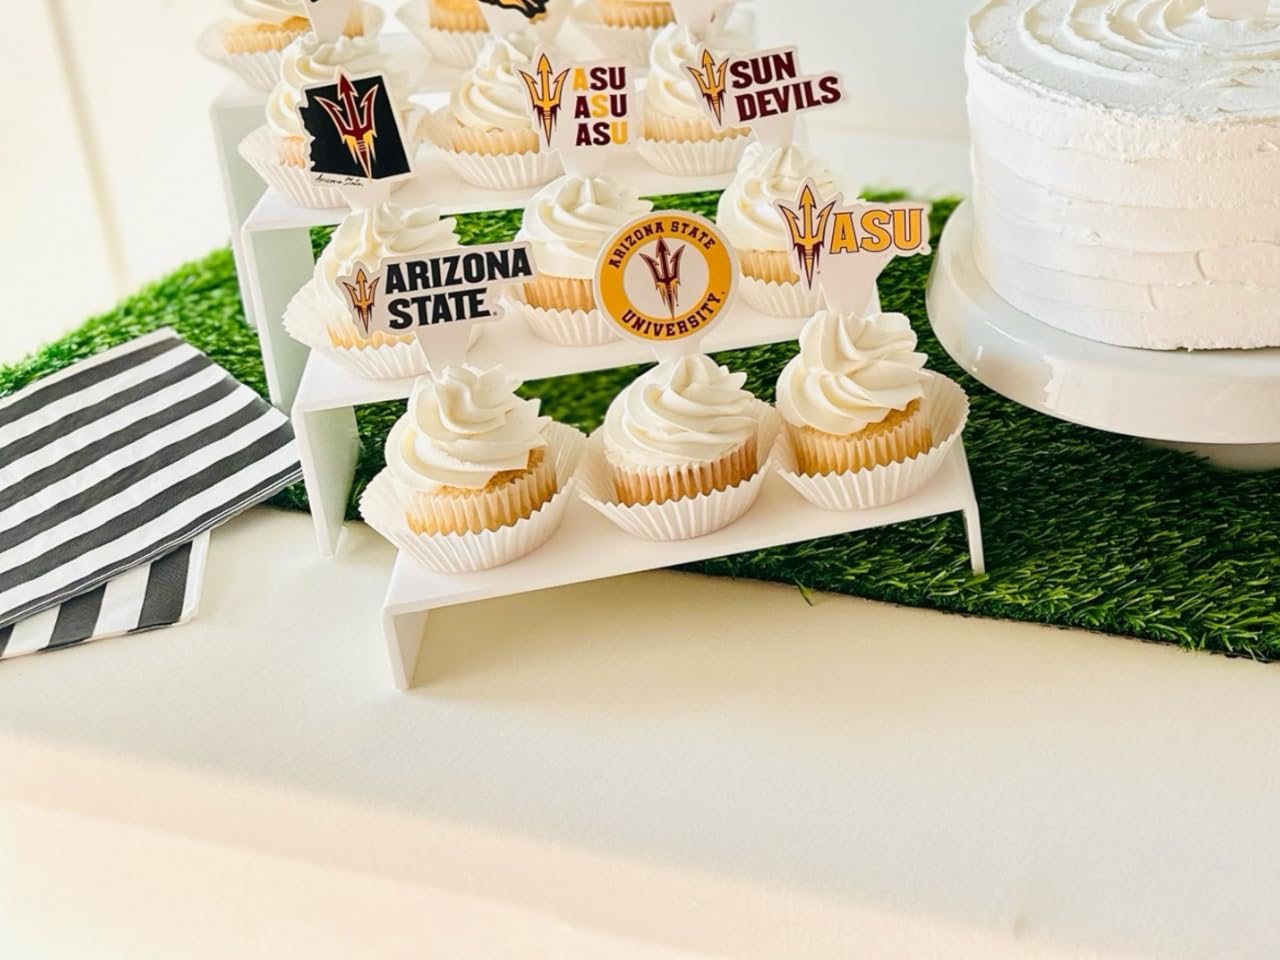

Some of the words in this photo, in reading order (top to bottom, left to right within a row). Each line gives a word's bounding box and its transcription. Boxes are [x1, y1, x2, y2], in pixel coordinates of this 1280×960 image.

[573, 66, 626, 91] ASU
[729, 51, 797, 89] SUN
[574, 94, 627, 119] ASU
[735, 76, 842, 122] DEVILS
[576, 121, 628, 146] ASU
[608, 222, 665, 268] ARIZONA
[670, 221, 716, 250] STATE
[830, 208, 924, 254] ASU
[385, 247, 533, 294] ARIZONA
[388, 287, 491, 329] STATE
[621, 292, 720, 336] UNIVERSITY
